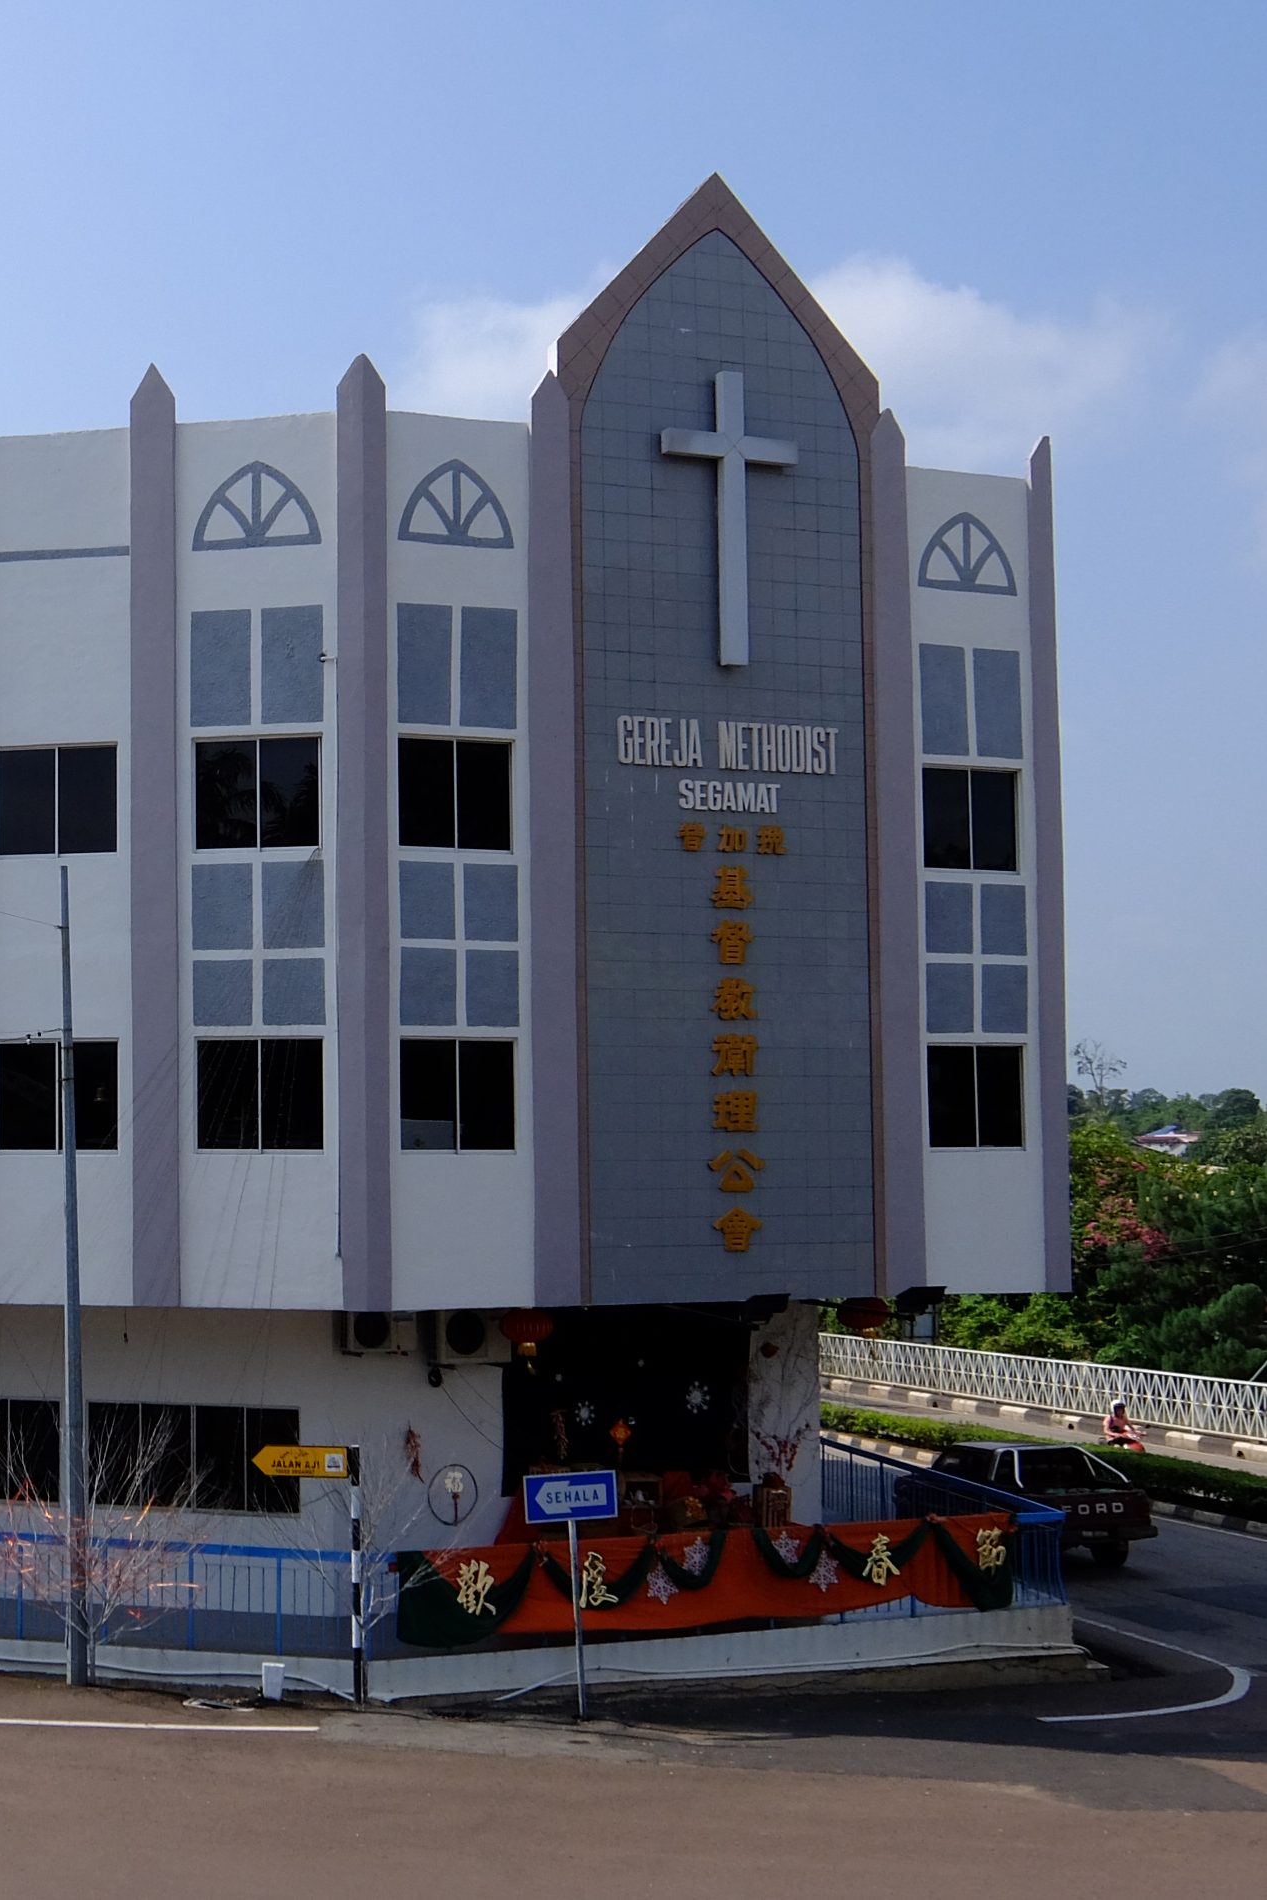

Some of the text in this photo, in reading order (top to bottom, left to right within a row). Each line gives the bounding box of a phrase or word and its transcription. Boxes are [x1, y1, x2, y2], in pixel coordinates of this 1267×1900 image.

[616, 714, 839, 776] GEREJA METHODIST
[678, 779, 781, 814] SEGAMAT
[710, 865, 765, 1253] 基督教衛理公會
[271, 1460, 320, 1470] JALAN AJI
[545, 1489, 600, 1505] SEHALA
[1061, 1502, 1125, 1515] FORD
